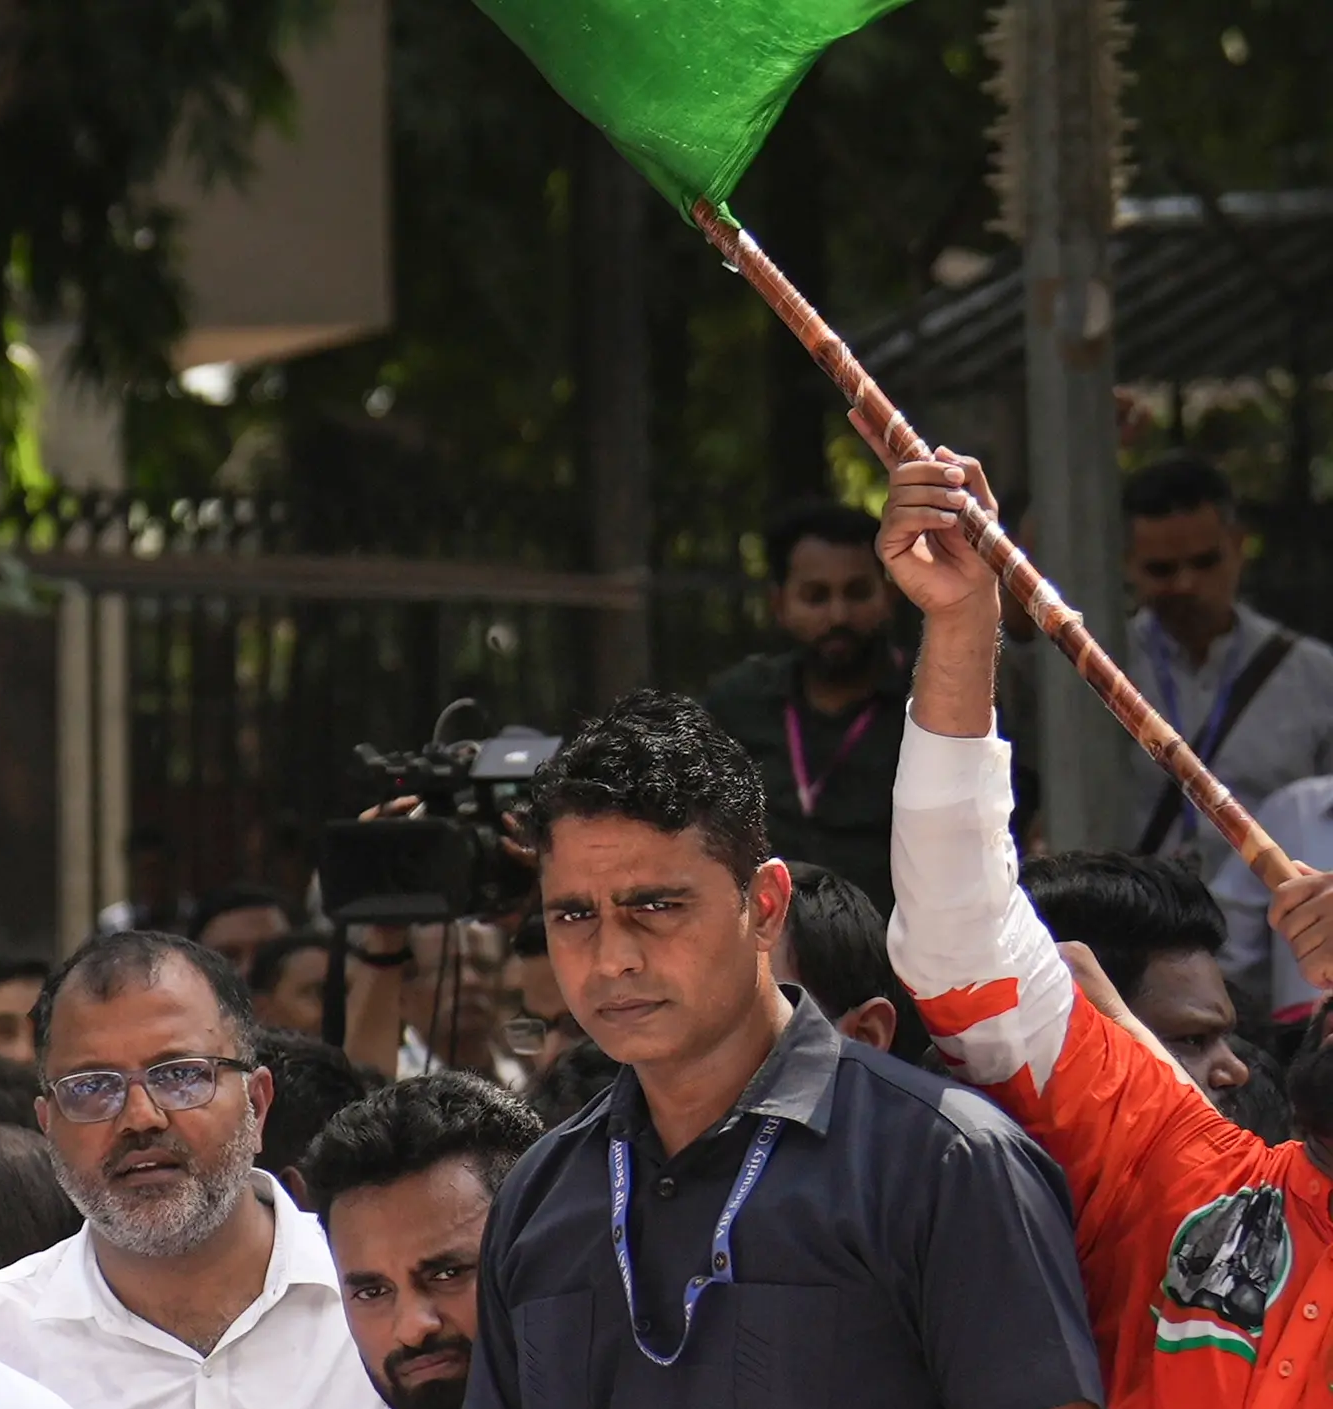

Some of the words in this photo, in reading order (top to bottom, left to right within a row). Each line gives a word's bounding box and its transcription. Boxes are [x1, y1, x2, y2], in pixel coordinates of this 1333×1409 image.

[612, 1190, 624, 1218] VIP
[715, 1206, 733, 1240] VIP
[729, 1148, 768, 1211] Security
